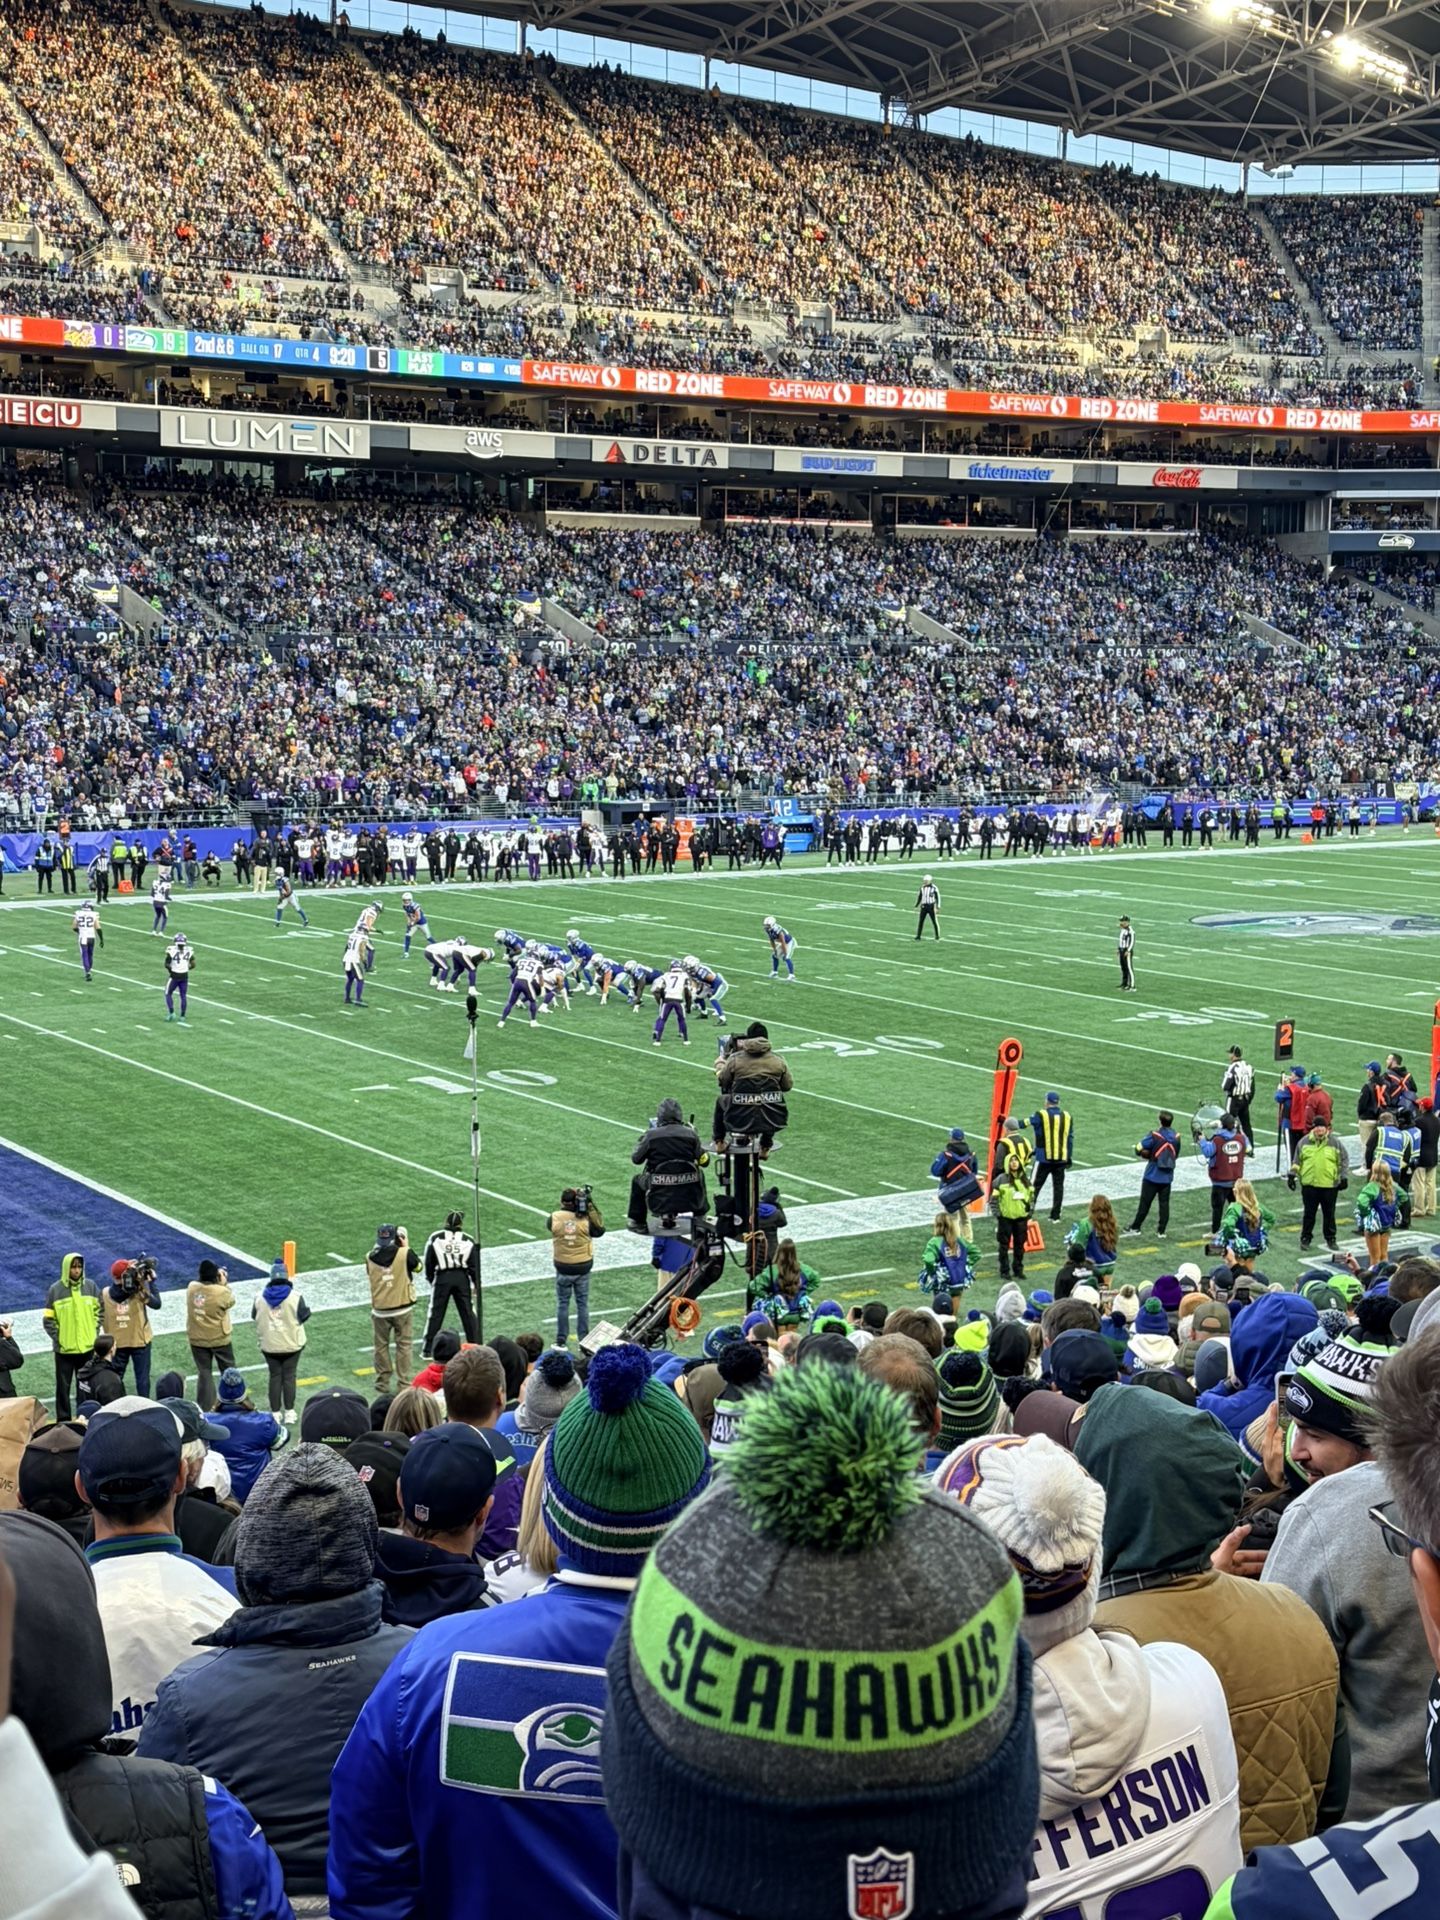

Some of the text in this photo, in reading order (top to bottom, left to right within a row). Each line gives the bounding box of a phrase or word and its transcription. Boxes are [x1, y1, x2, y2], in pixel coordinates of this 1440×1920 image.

[103, 327, 113, 346] 0
[162, 333, 175, 350] 19
[194, 335, 215, 353] 2nd
[216, 339, 226, 355] &
[273, 343, 283, 358] 17
[312, 347, 320, 362] 4
[329, 346, 356, 366] 9:20
[408, 352, 433, 364] LAST
[378, 352, 386, 368] 5
[408, 362, 434, 374] PLAY
[533, 364, 600, 384] SAFEWAY
[636, 370, 724, 395] RED ZONE
[768, 382, 833, 400] SAFEWAY
[864, 385, 947, 410] RED ZONE
[989, 395, 1050, 413] SAFEWAY
[1080, 399, 1159, 420] RED ZONE
[1200, 407, 1257, 423] SAFEWAY
[1286, 410, 1362, 429] RED ZONE
[179, 414, 355, 455] LUMEN
[466, 431, 502, 447] aws
[633, 444, 717, 466] DELTA
[968, 463, 1055, 481] ticketmaster
[78, 916, 94, 928] 22
[172, 951, 190, 964] 44
[518, 960, 536, 973] 55
[670, 975, 678, 989] 7
[1279, 1023, 1293, 1047] 2
[733, 1091, 782, 1104] CHAPMAN
[652, 1174, 698, 1185] CHAPMAN
[445, 1244, 461, 1255] 95
[308, 1654, 357, 1670] SEAHAWKS
[659, 1612, 1000, 1742] SEAHAWKS
